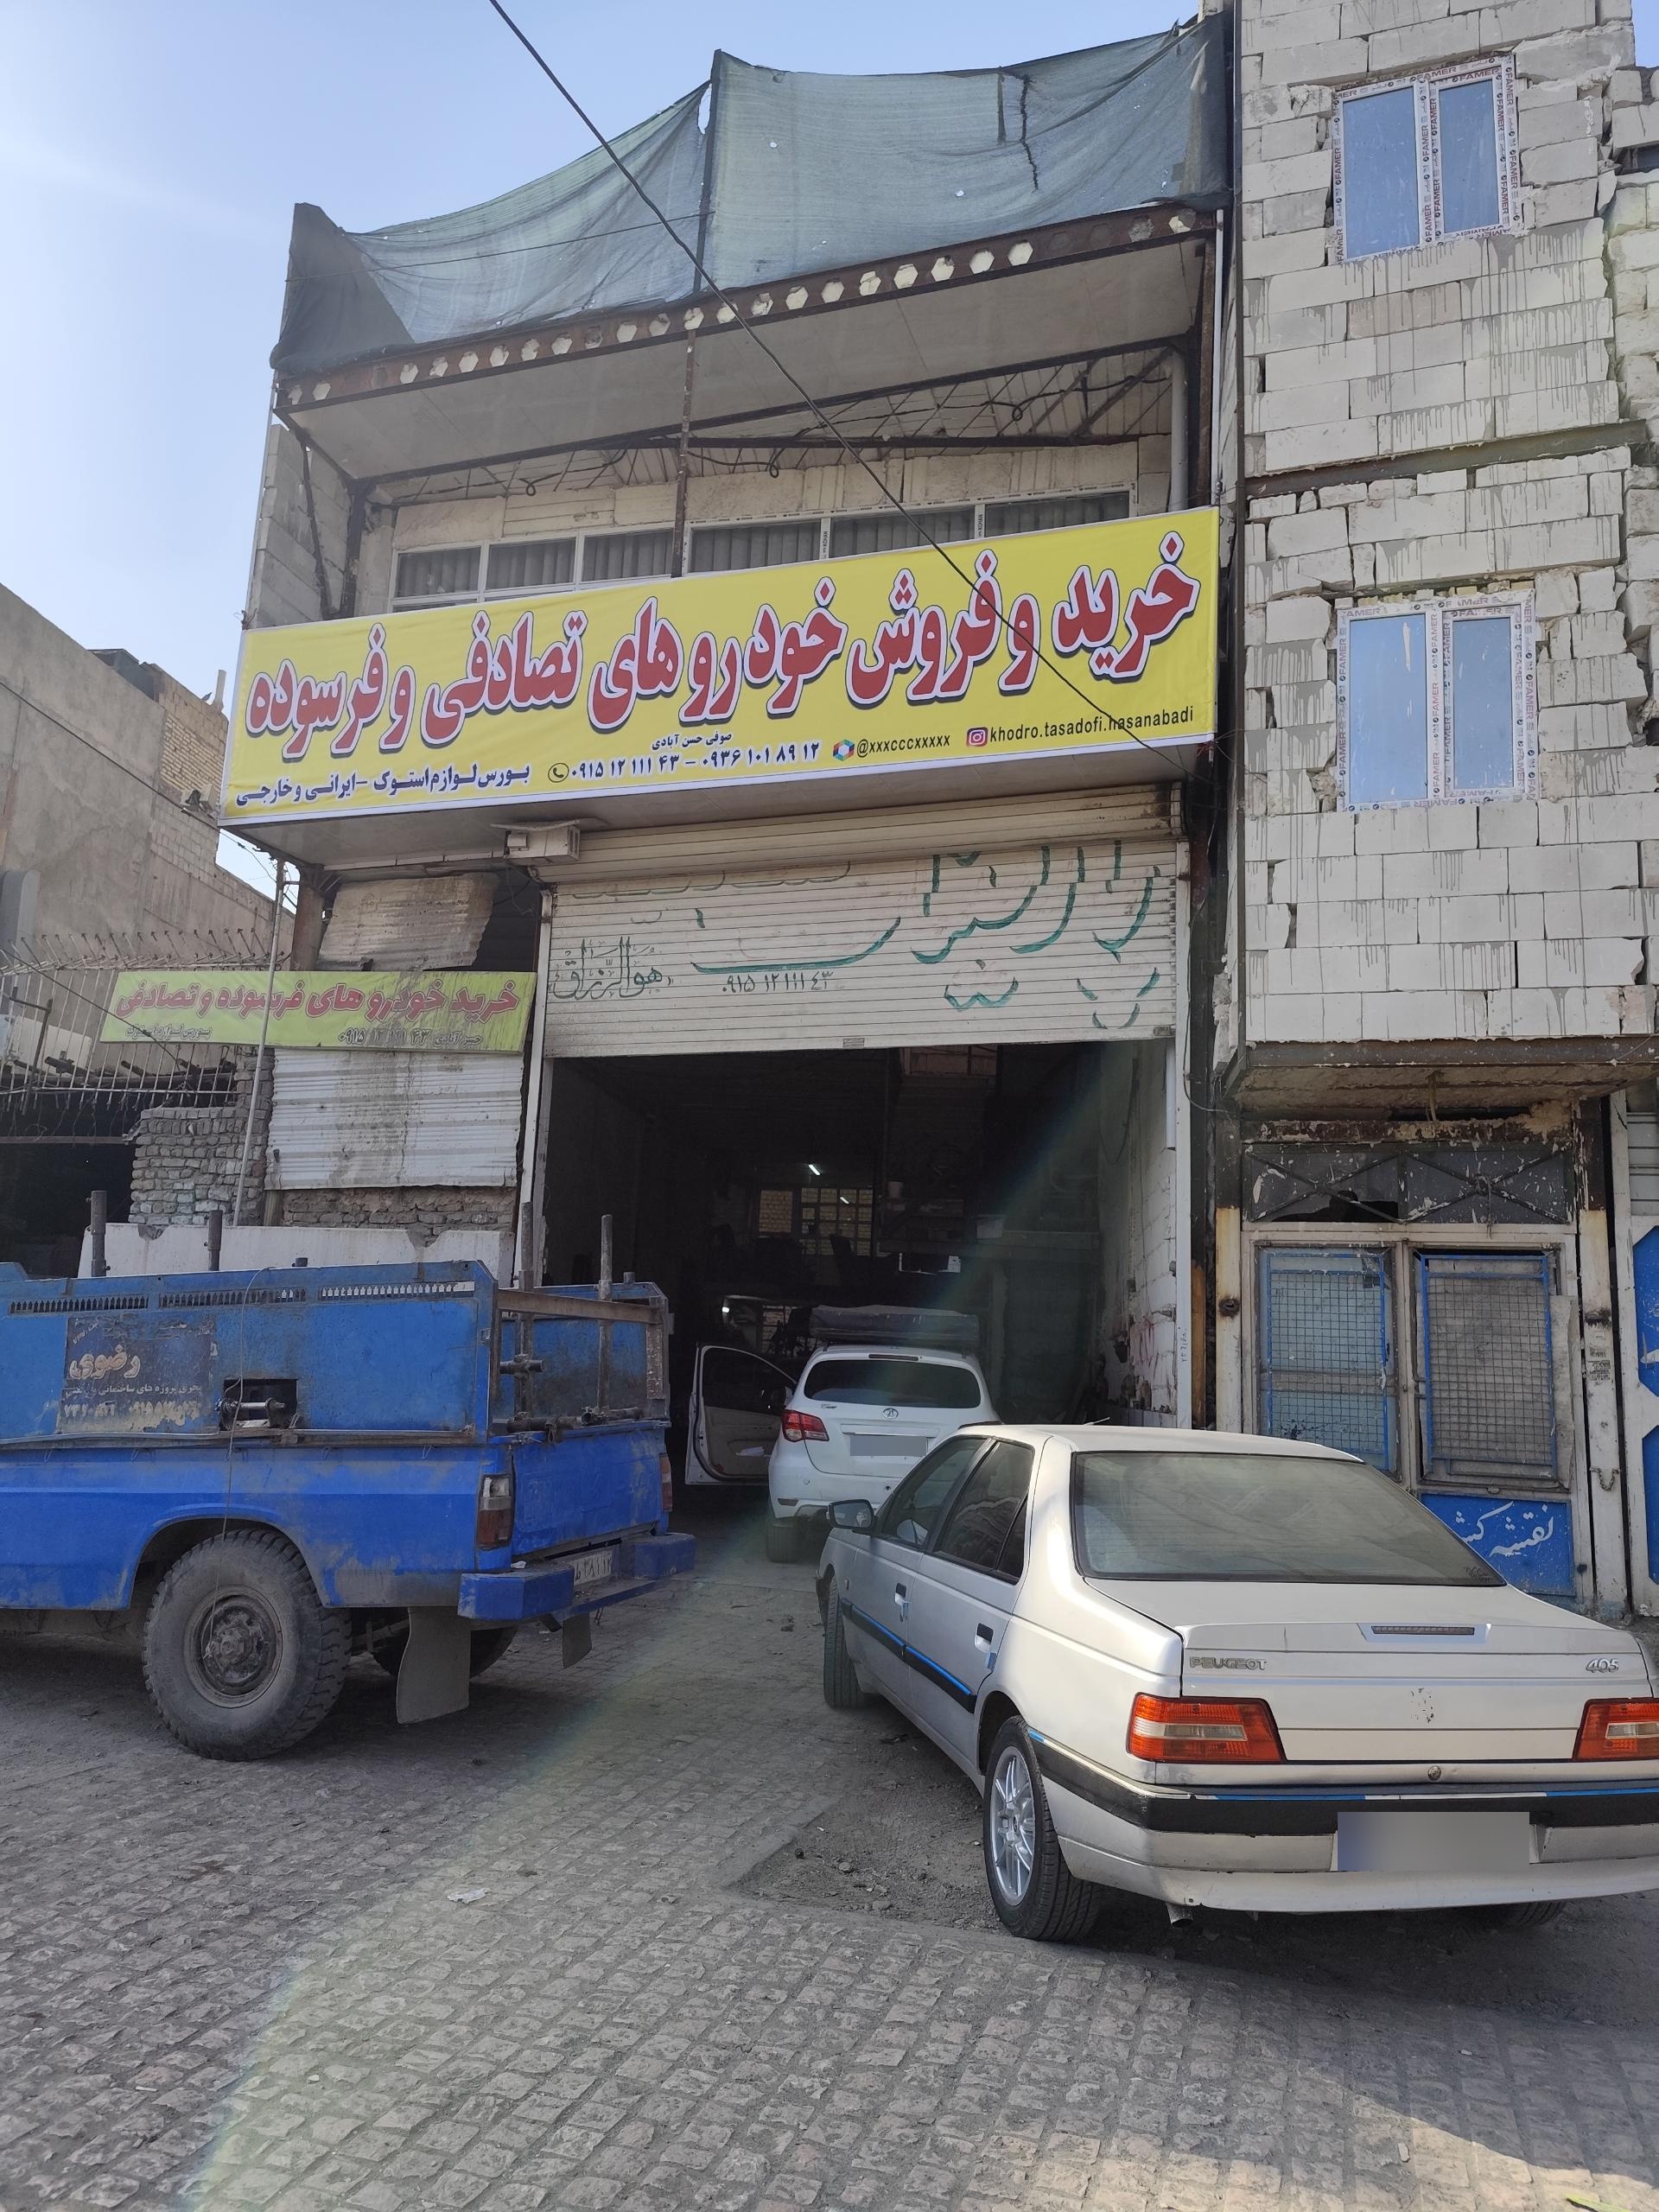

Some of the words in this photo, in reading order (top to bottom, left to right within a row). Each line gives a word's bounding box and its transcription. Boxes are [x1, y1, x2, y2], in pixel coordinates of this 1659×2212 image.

[1459, 68, 1500, 80] FAMER
[1053, 531, 1200, 679] خرید
[847, 549, 1002, 703] فروش
[999, 594, 1040, 693] و
[421, 609, 588, 746] تصادفی
[588, 597, 683, 731] های
[245, 621, 388, 760] فرسوده
[380, 664, 416, 752] و
[652, 734, 680, 751] آبادی
[682, 735, 702, 748] حسن
[706, 731, 732, 746] صوفی
[990, 706, 1194, 743] khodro.tasadofi.hasanabadi
[374, 767, 429, 795] استوک
[430, 764, 477, 792] لوازم
[479, 765, 530, 787] بورس
[115, 980, 200, 1019] تصادفی
[197, 989, 213, 1019] و
[216, 980, 305, 1020] فرسوده
[451, 981, 519, 1024] خرید
[1189, 1656, 1267, 1670] PEUGEOT
[1586, 1658, 1619, 1673] 405
